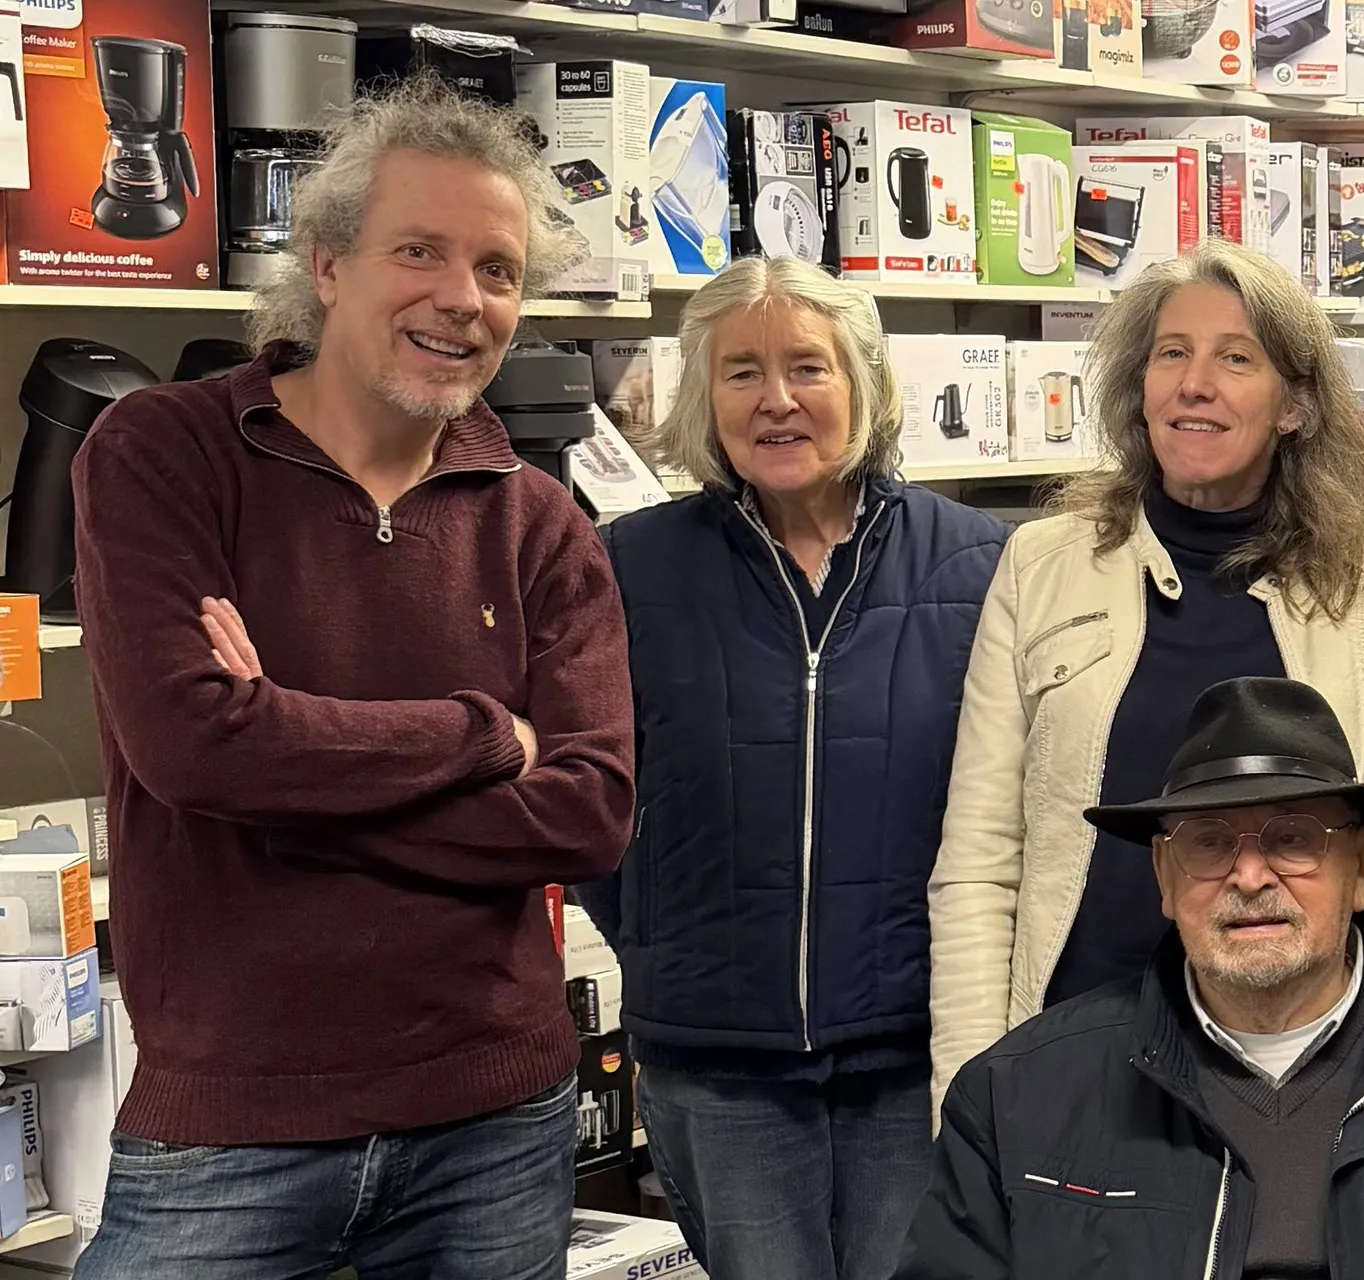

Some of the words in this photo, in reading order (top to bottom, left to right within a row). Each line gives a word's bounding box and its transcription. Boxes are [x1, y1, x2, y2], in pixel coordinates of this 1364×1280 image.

[916, 21, 956, 37] PHILIPS
[23, 34, 47, 47] offee
[49, 36, 77, 49] Maker
[1099, 49, 1134, 65] magimix
[894, 109, 957, 135] Tefal
[1086, 127, 1147, 141] Tefal
[822, 128, 833, 161] AEG
[18, 249, 61, 265] Simply
[63, 251, 115, 265] delicious
[116, 253, 154, 266] coffee
[20, 267, 38, 275] With
[84, 269, 94, 278] for
[95, 270, 106, 278] the
[107, 270, 121, 279] best
[611, 347, 648, 355] SEVERIN
[962, 349, 1000, 364] GRAEF
[20, 1089, 38, 1156] PHILIPS
